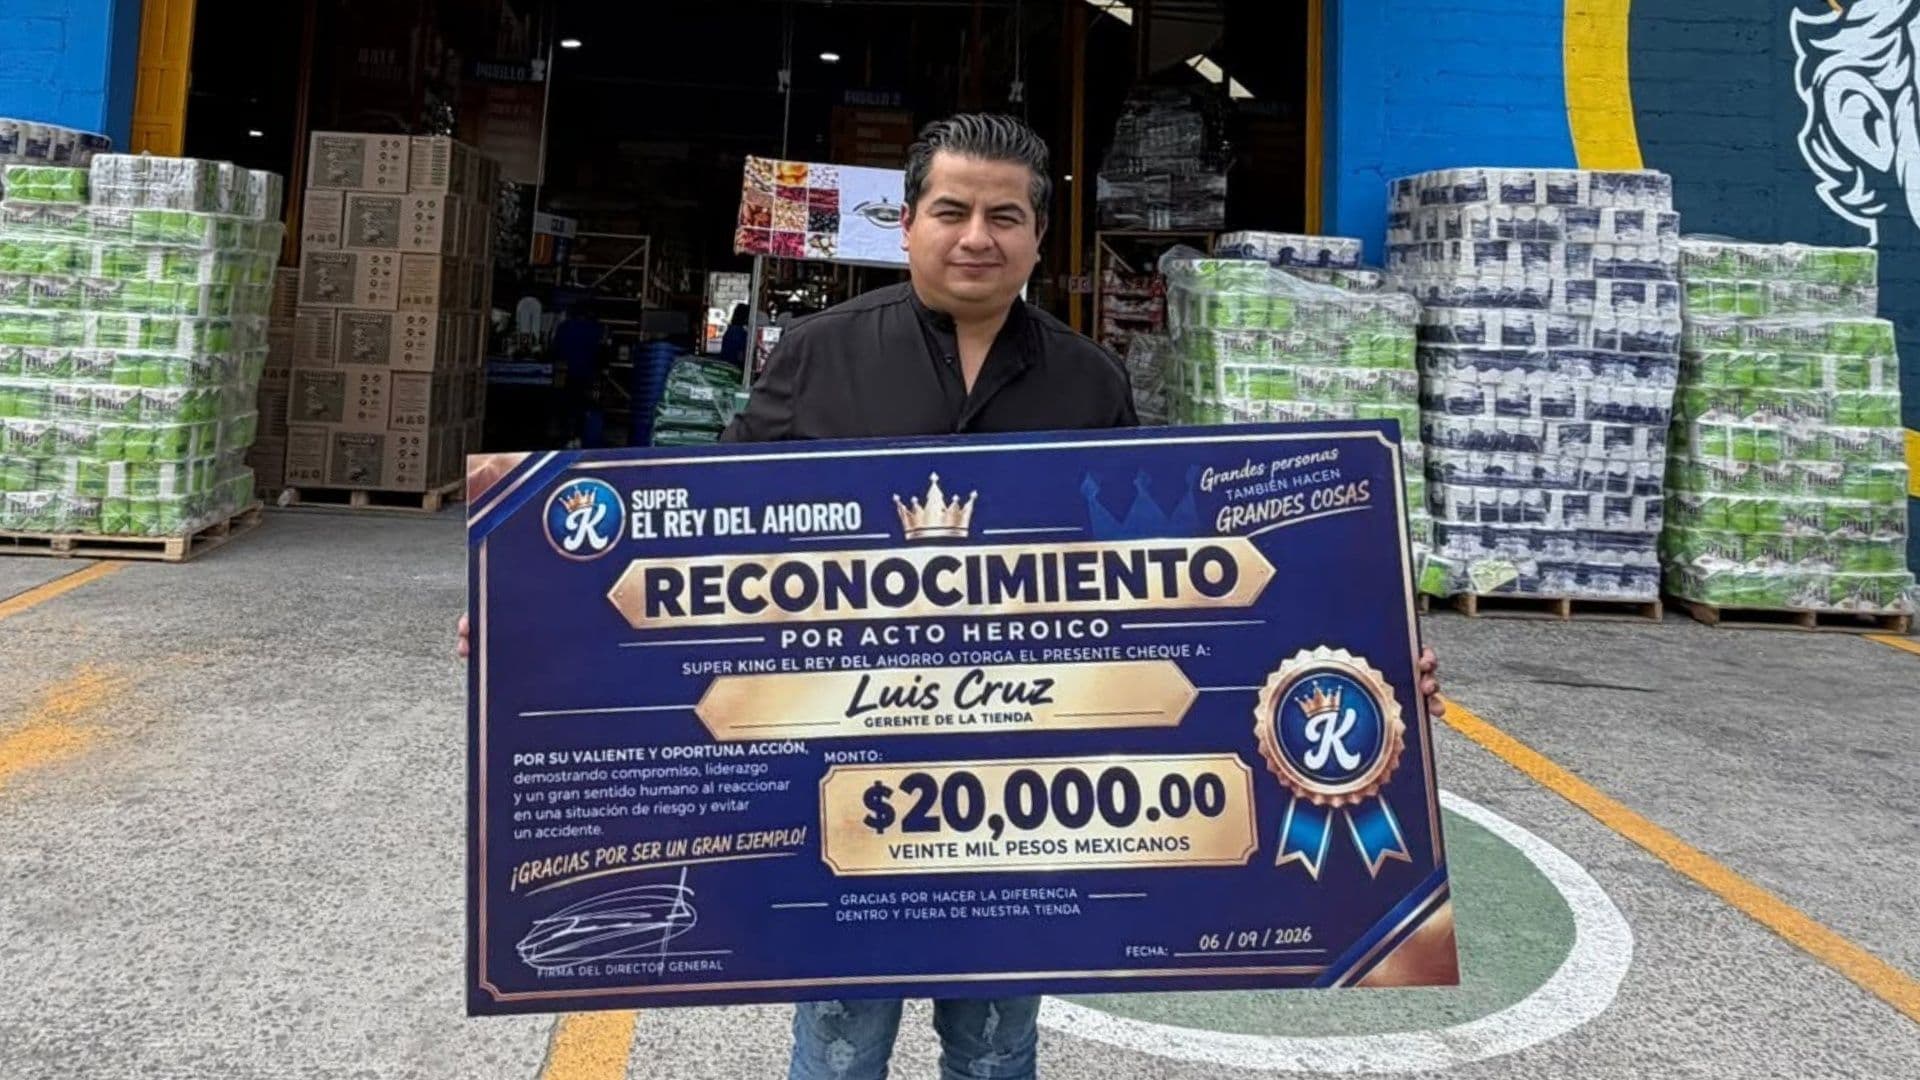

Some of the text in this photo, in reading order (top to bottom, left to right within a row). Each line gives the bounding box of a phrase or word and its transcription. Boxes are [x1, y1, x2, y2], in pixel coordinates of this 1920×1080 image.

[1200, 448, 1340, 493] Grandes personas
[1226, 468, 1341, 501] TAMBIÉN HACEN
[631, 488, 689, 511] SUPER
[1216, 479, 1371, 533] GRANDES COSAS
[631, 502, 862, 540] EL REY DEL AHORRO
[644, 545, 1240, 618] RECONOCIMIENTO
[780, 619, 1110, 649] POR ACTO HEROICO
[682, 644, 1211, 676] SUPER KING EL REY DEL AHORRO OTORGA EL PRESENTE CHEQUE A:
[844, 669, 1055, 718] Luis Cruz
[864, 711, 1034, 728] GERENTE DE LA TIENDA
[514, 739, 809, 767] POR SU VALIENTE Y OPORTUNA ACCIÓN,
[1303, 708, 1360, 770] K
[824, 750, 884, 763] MONTO:
[514, 762, 769, 784] demostrando compromiso, liderazgo
[514, 779, 791, 806] y un gran sentido humano al reaccionar
[862, 766, 1226, 840] $20,000.00
[514, 798, 751, 822] en una situación de riesgo y evitar
[514, 825, 605, 839] un accidente.
[510, 826, 807, 892] ¡GRACIAS POR SER UN GRAN EJEMPLO!
[888, 836, 1191, 860] VEINTE MIL PESOS MEXICANOS
[836, 903, 1081, 921] DENTRO Y FUERA DE NUESTRA TIENDA
[840, 893, 897, 906] GRACIAS
[901, 892, 928, 904] POR
[932, 890, 976, 902] HACER
[981, 889, 997, 901] LA
[1126, 946, 1168, 958] FECHA:
[1199, 934, 1220, 951] 06
[1238, 930, 1258, 948] 09
[1275, 926, 1313, 945] 2026
[579, 965, 601, 977] DEL
[668, 960, 723, 973] GENERAL
